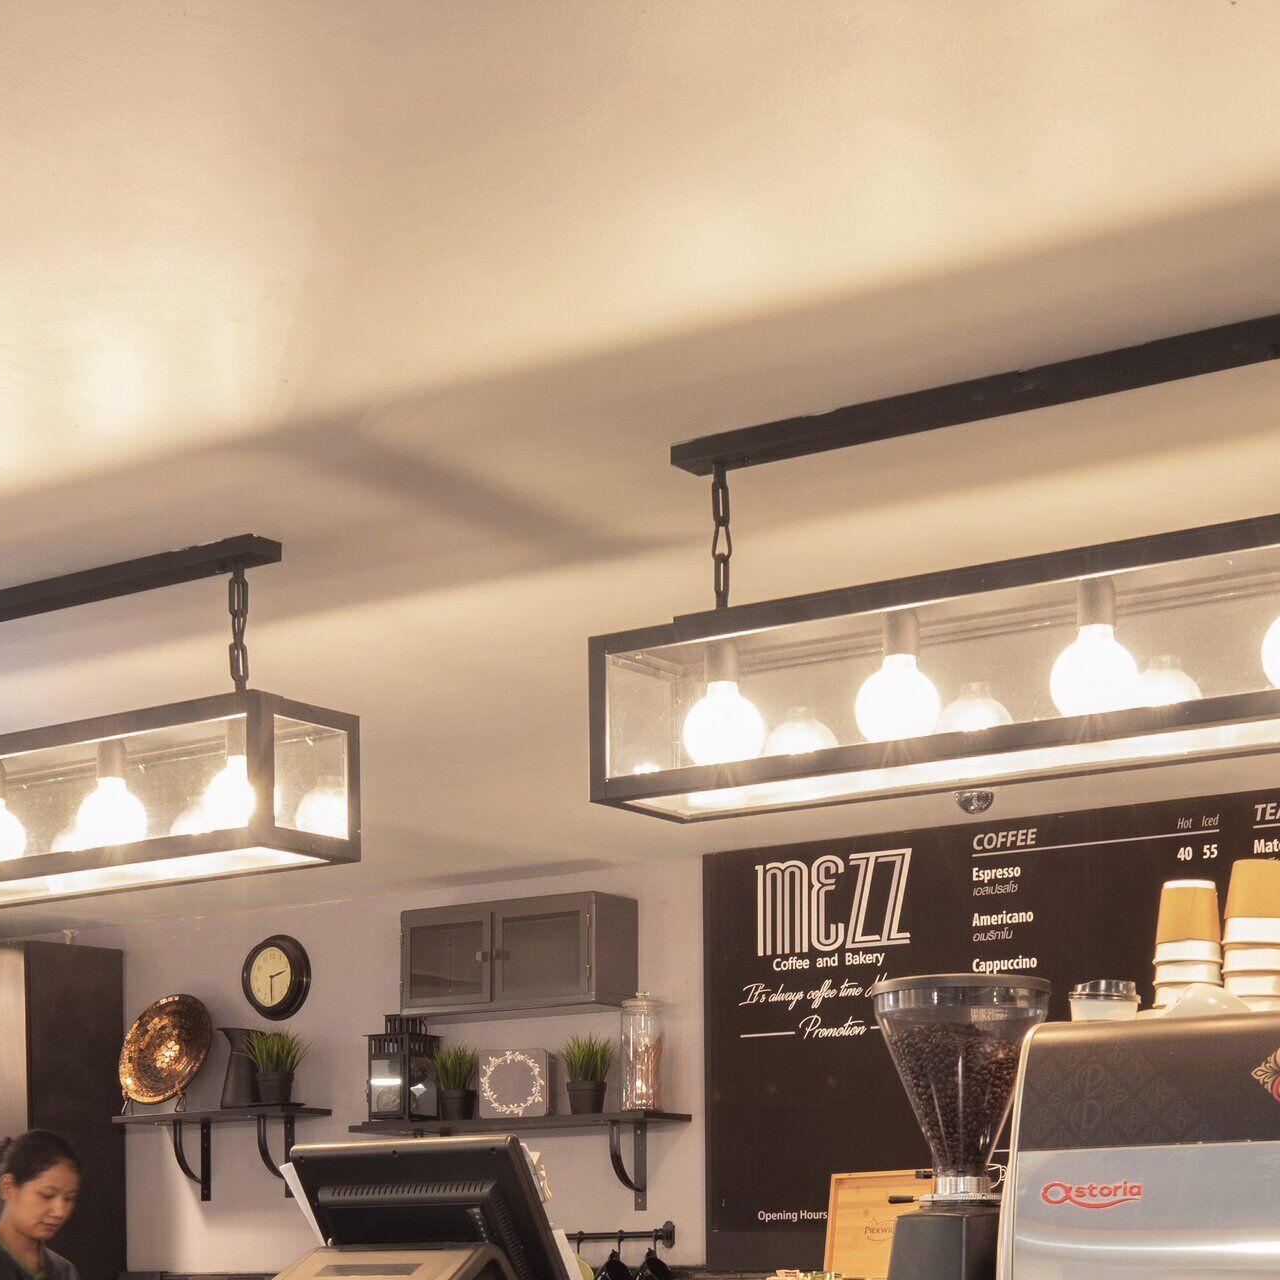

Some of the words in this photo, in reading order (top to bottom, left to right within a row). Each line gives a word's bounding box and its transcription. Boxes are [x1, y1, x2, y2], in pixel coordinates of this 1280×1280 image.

[1177, 817, 1193, 829] Hot
[1201, 814, 1219, 828] Iced
[972, 828, 1037, 850] COFFEE
[1177, 846, 1193, 861] 40
[1202, 844, 1218, 859] 55
[972, 865, 1021, 883] Espresso
[972, 910, 1034, 927] Americano
[773, 957, 810, 972] Coffee
[816, 954, 838, 968] and
[845, 951, 885, 967] Bakery
[972, 955, 1038, 974] Cappuccino
[739, 982, 766, 1006] It's
[768, 983, 805, 1010] always
[807, 980, 838, 1008] coffee
[839, 980, 863, 998] time
[799, 1014, 867, 1040] Promotion
[758, 1211, 798, 1222] Opening
